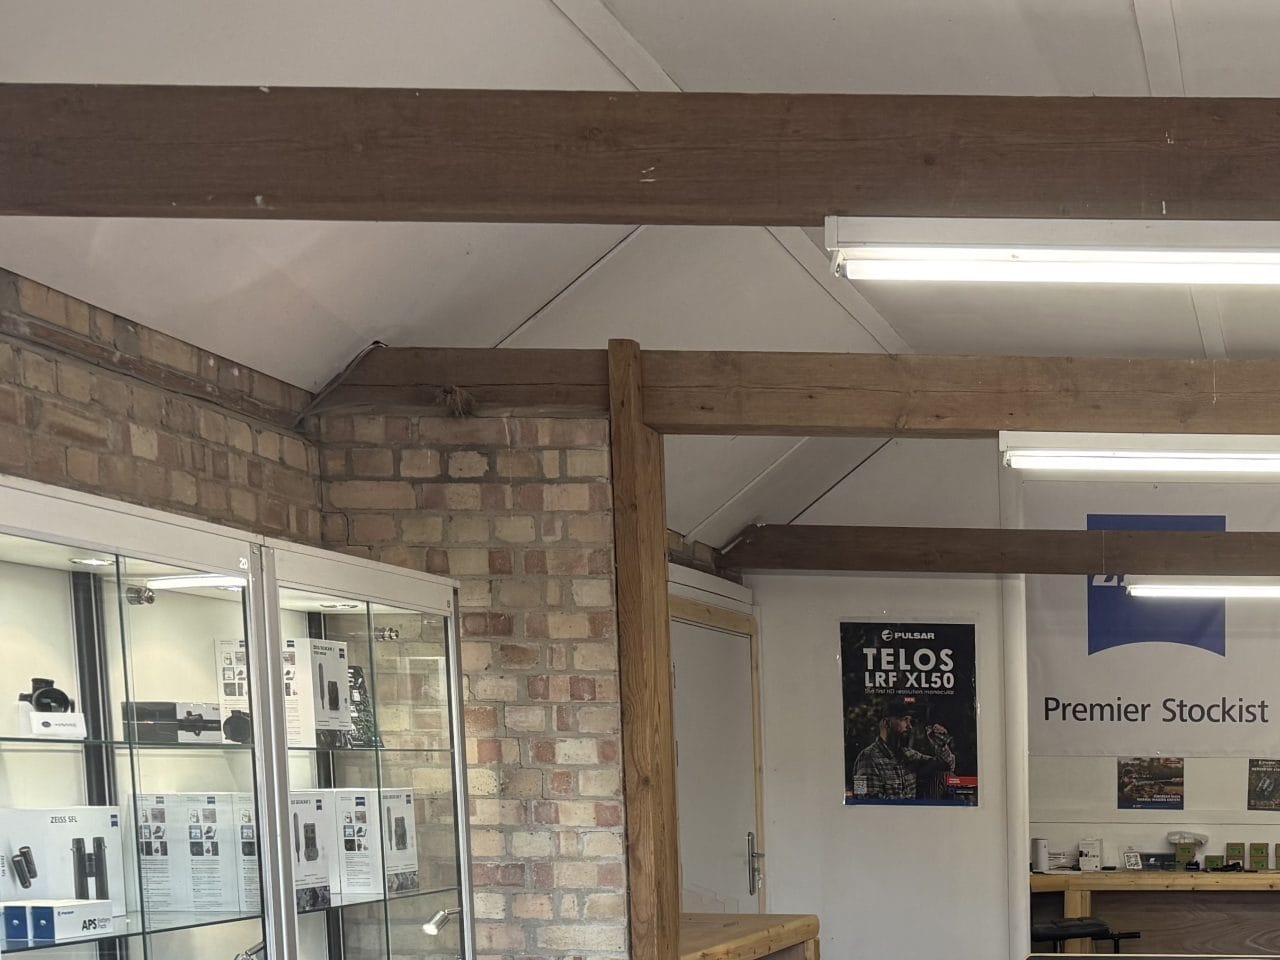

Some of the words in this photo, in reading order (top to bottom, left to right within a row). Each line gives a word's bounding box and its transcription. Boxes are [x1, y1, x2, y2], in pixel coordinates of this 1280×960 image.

[863, 648, 954, 671] TELOS
[865, 672, 897, 687] LRF
[905, 672, 954, 688] XL50
[1043, 697, 1151, 722] Premier
[1162, 697, 1269, 723] Stockist
[82, 918, 97, 931] APS
